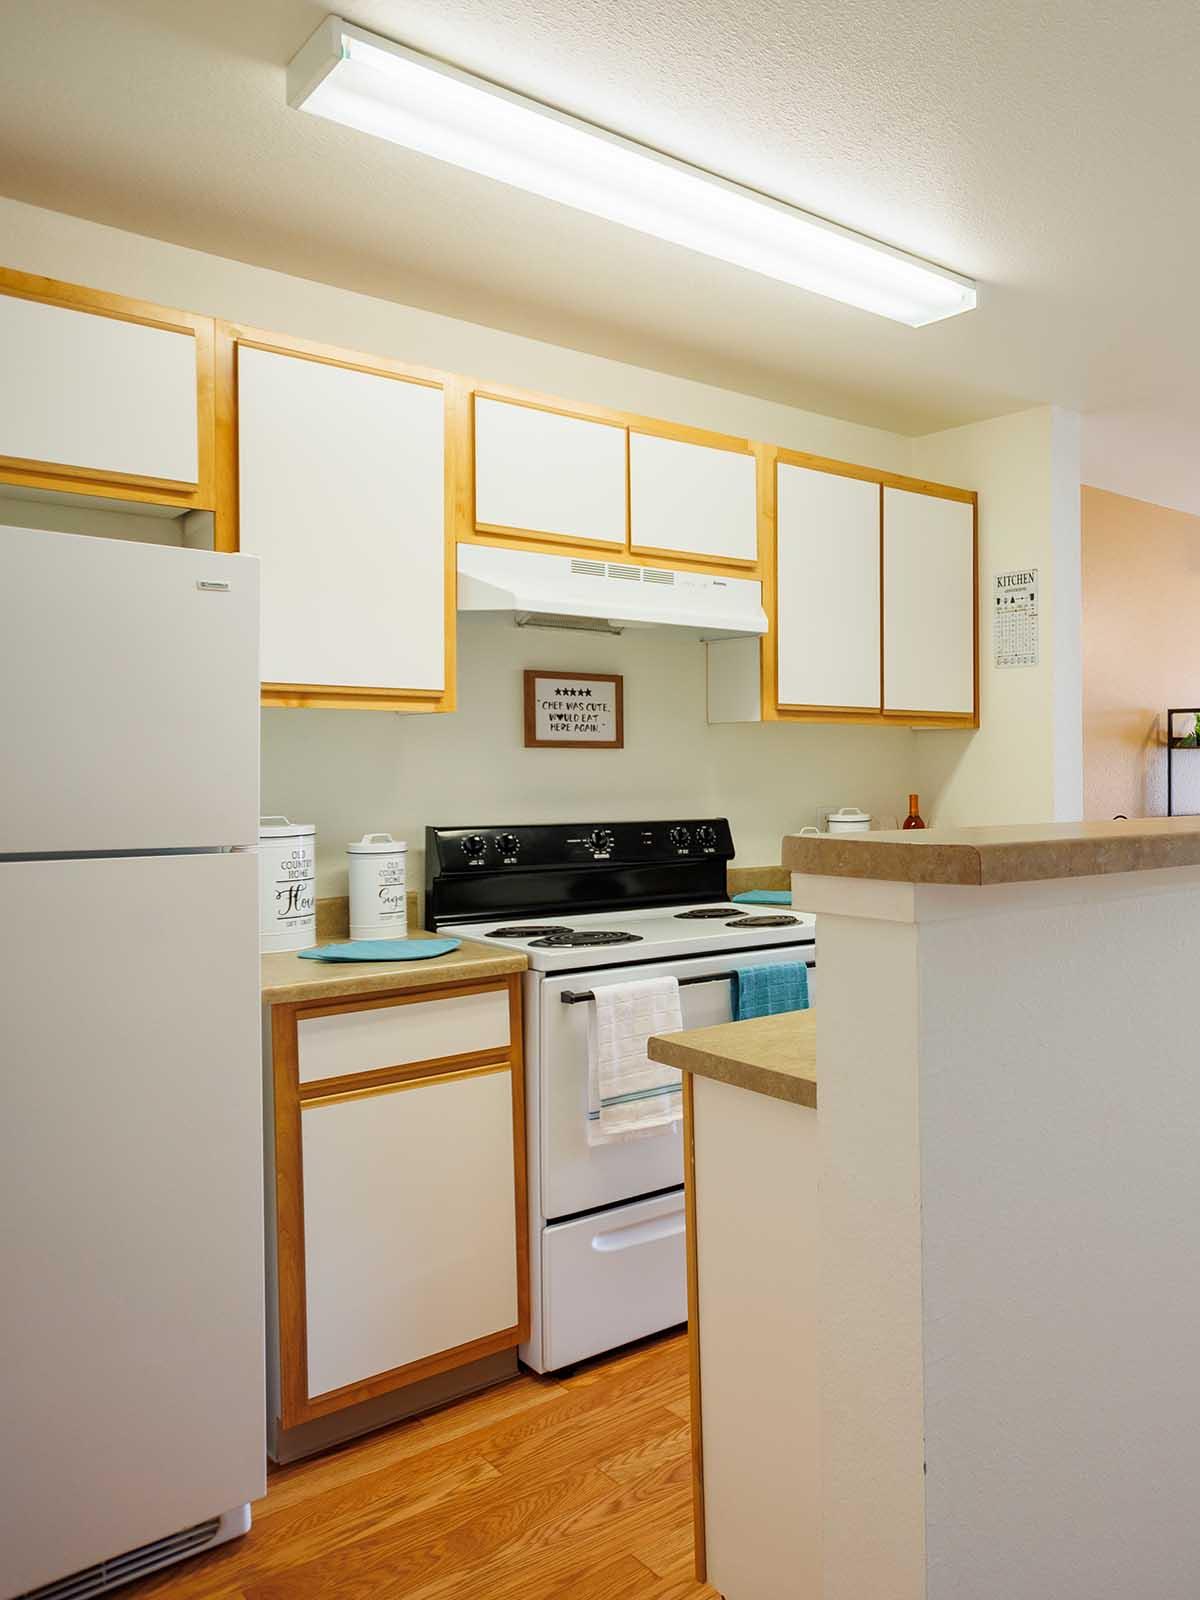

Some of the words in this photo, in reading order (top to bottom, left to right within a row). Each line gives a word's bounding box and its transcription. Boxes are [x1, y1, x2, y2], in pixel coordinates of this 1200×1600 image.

[997, 572, 1035, 588] KITCHEN
[566, 702, 584, 711] WAS
[581, 713, 599, 723] EAT
[550, 722, 572, 732] HERE
